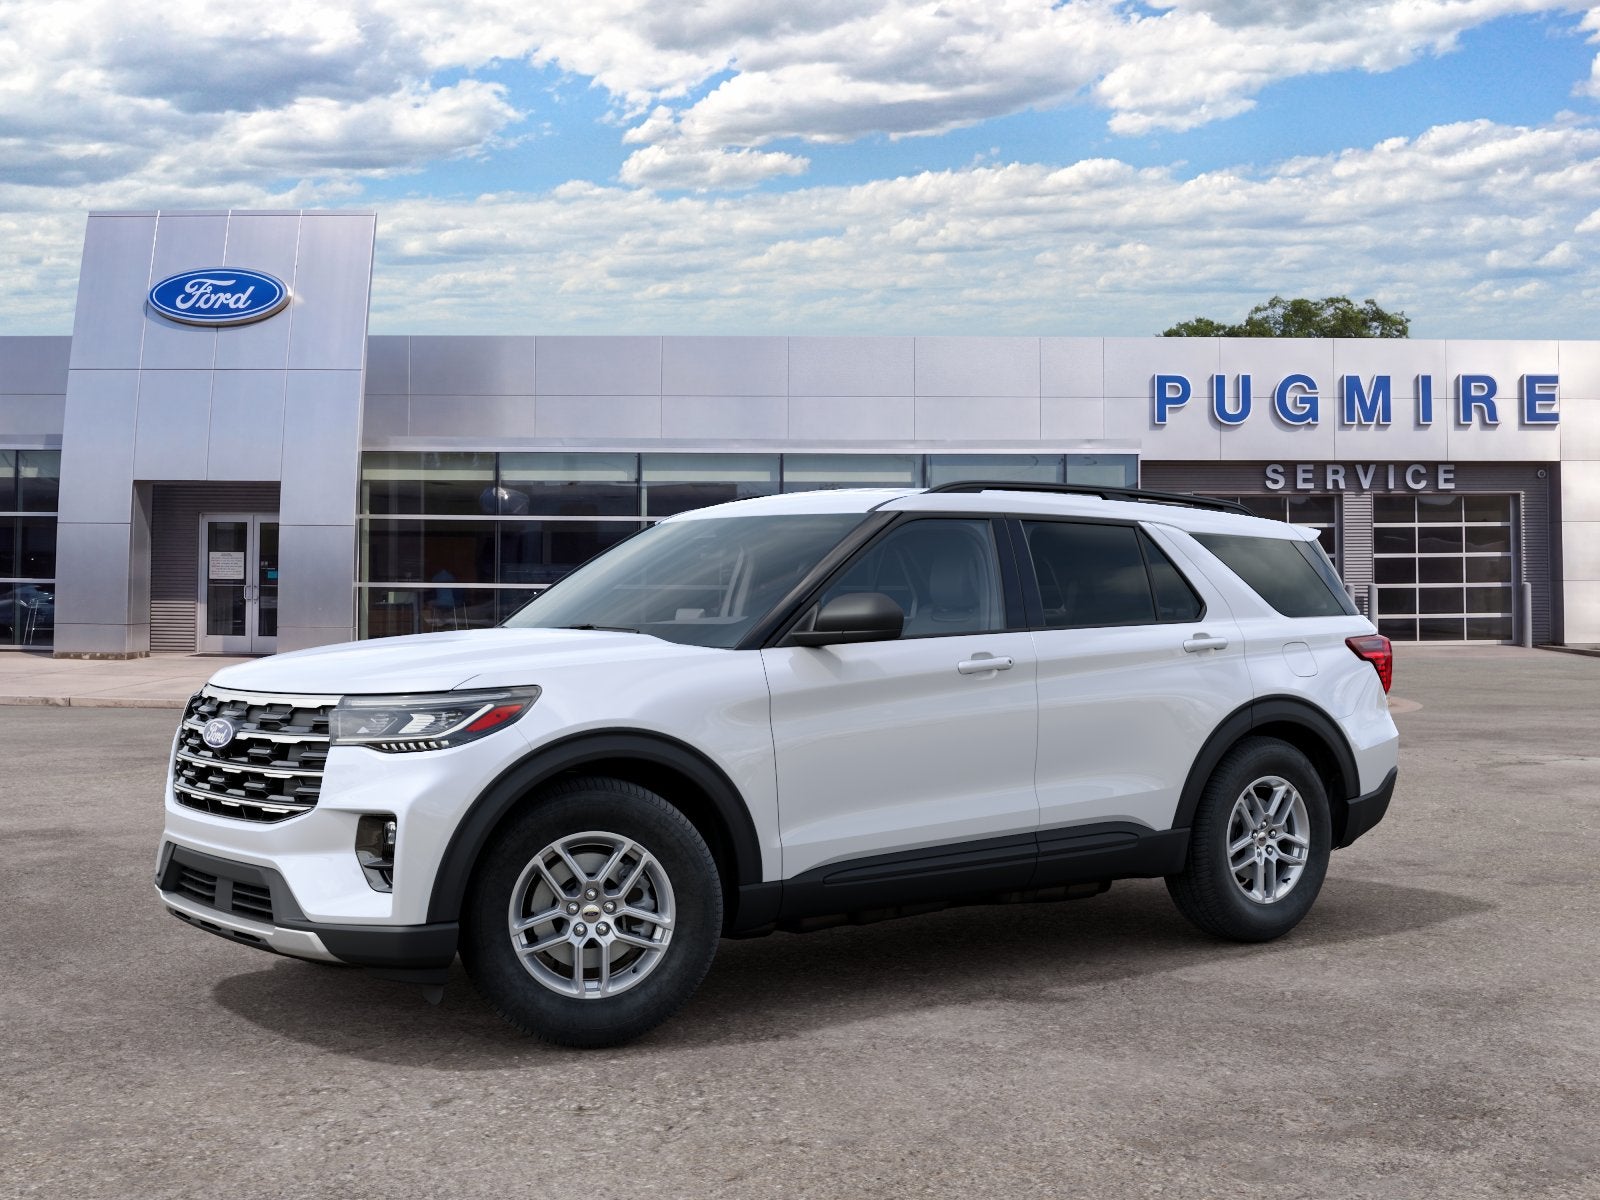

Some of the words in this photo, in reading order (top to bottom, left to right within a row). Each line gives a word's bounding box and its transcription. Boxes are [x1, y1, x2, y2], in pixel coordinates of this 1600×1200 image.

[176, 278, 255, 309] Ford
[1154, 373, 1560, 426] PUGMIRE
[1265, 463, 1456, 491] SERVICE
